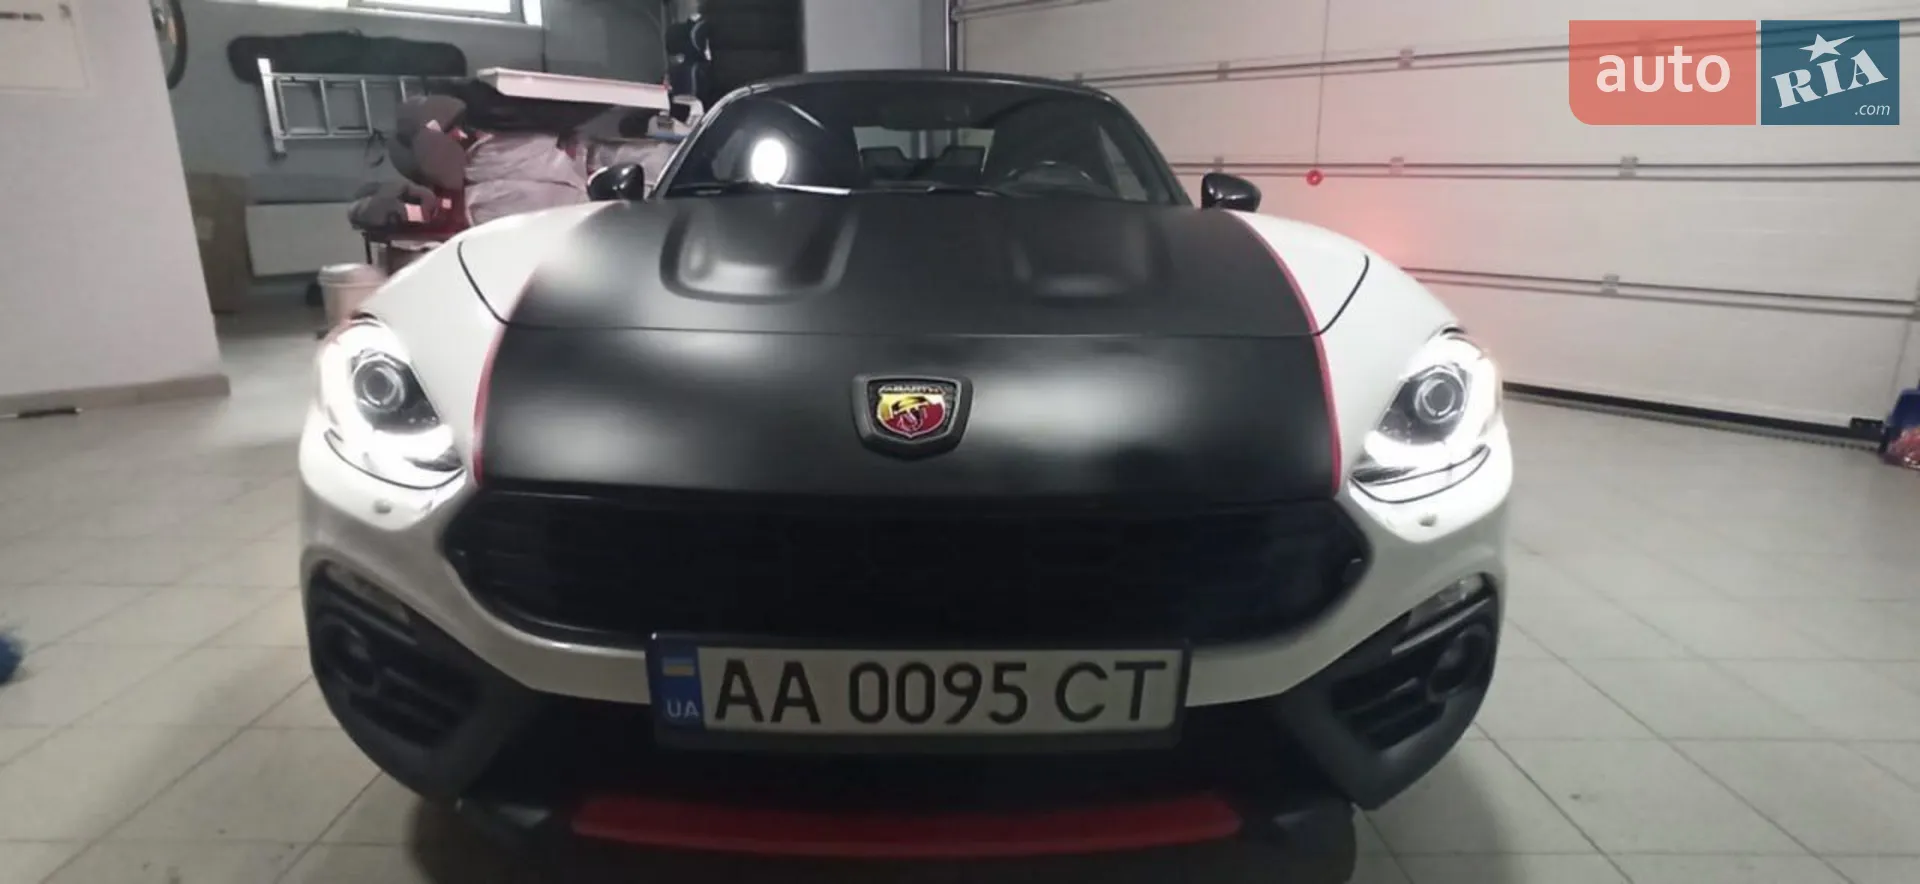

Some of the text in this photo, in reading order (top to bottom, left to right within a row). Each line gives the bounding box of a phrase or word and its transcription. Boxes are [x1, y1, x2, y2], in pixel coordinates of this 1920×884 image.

[666, 700, 699, 718] UA
[714, 659, 1167, 724] AA 0095 CT
